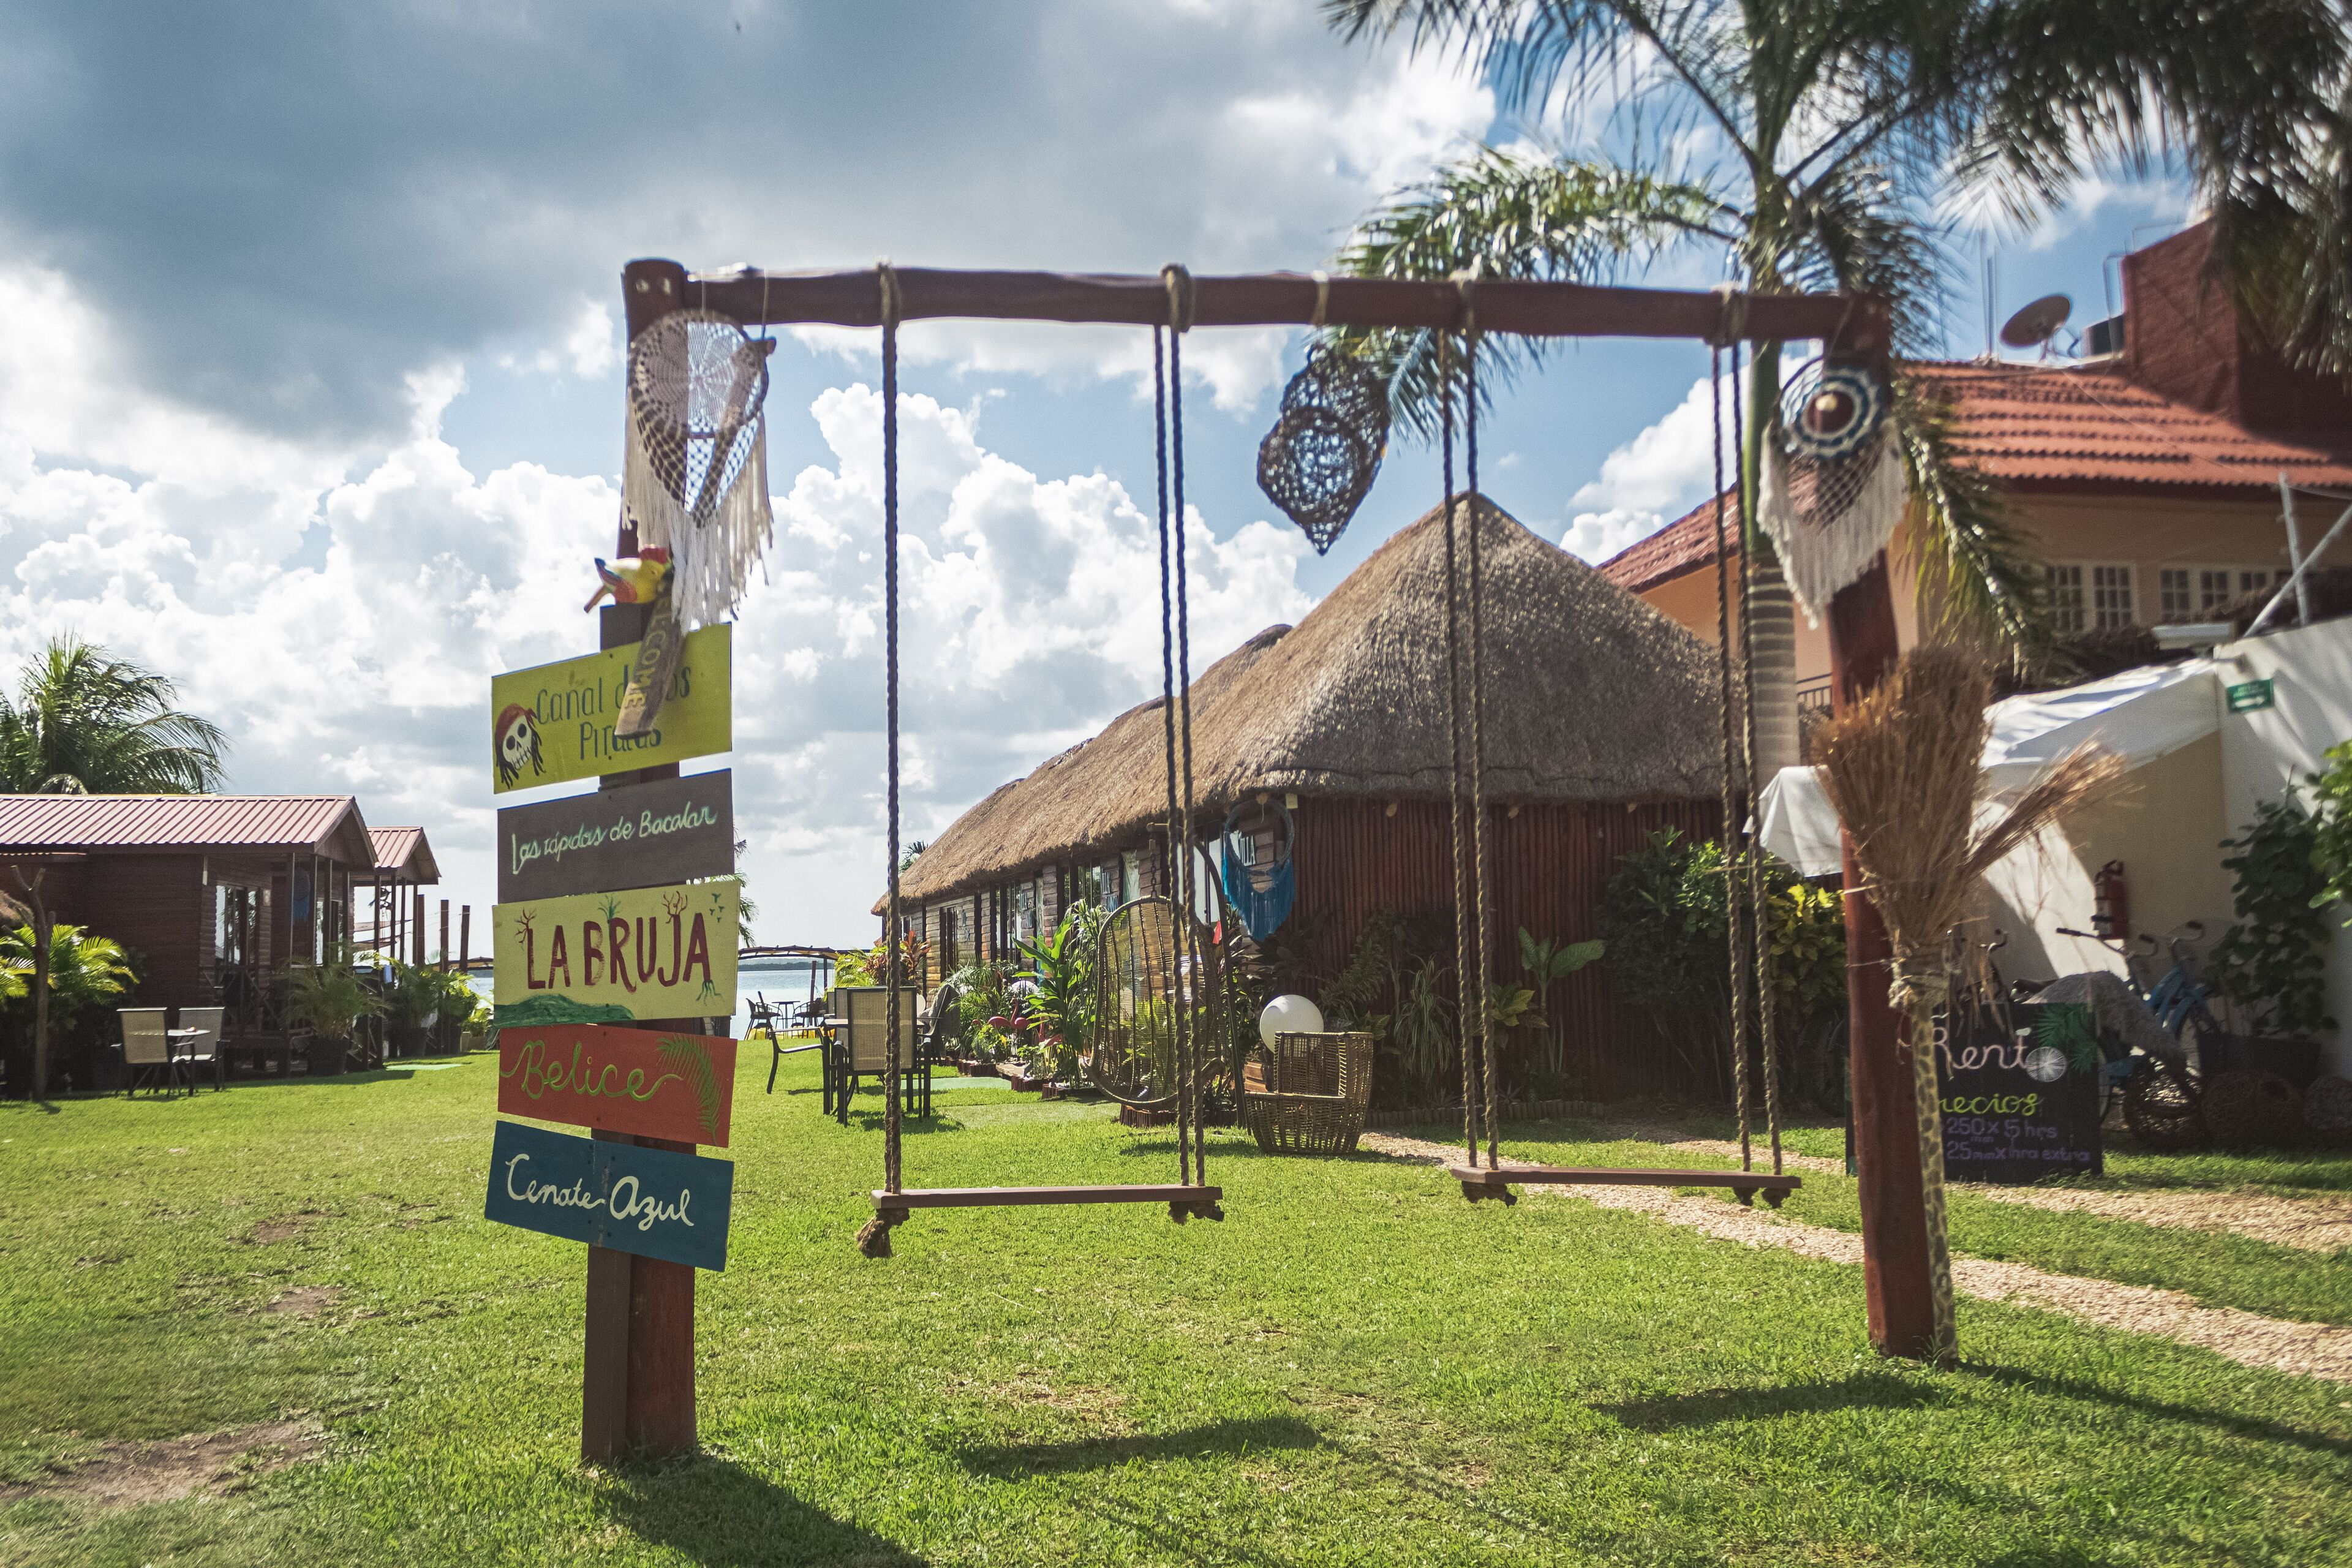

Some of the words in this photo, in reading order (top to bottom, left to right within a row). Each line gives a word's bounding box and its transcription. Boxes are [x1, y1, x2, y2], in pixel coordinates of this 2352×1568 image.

[623, 597, 673, 710] ELCOME
[536, 676, 603, 725] Canal
[609, 815, 636, 842] de
[639, 801, 717, 838] Bacalar
[527, 925, 570, 989] LA
[583, 913, 711, 993] BRUJA
[500, 1039, 684, 1102] Belice
[1933, 1028, 2059, 1071] Rent
[1939, 1093, 2041, 1117] recios
[1940, 1117, 1985, 1136] 250
[2003, 1119, 2021, 1138] 5
[2024, 1120, 2057, 1139] hrs
[2041, 1147, 2090, 1162] extra
[609, 1175, 695, 1231] Azul
